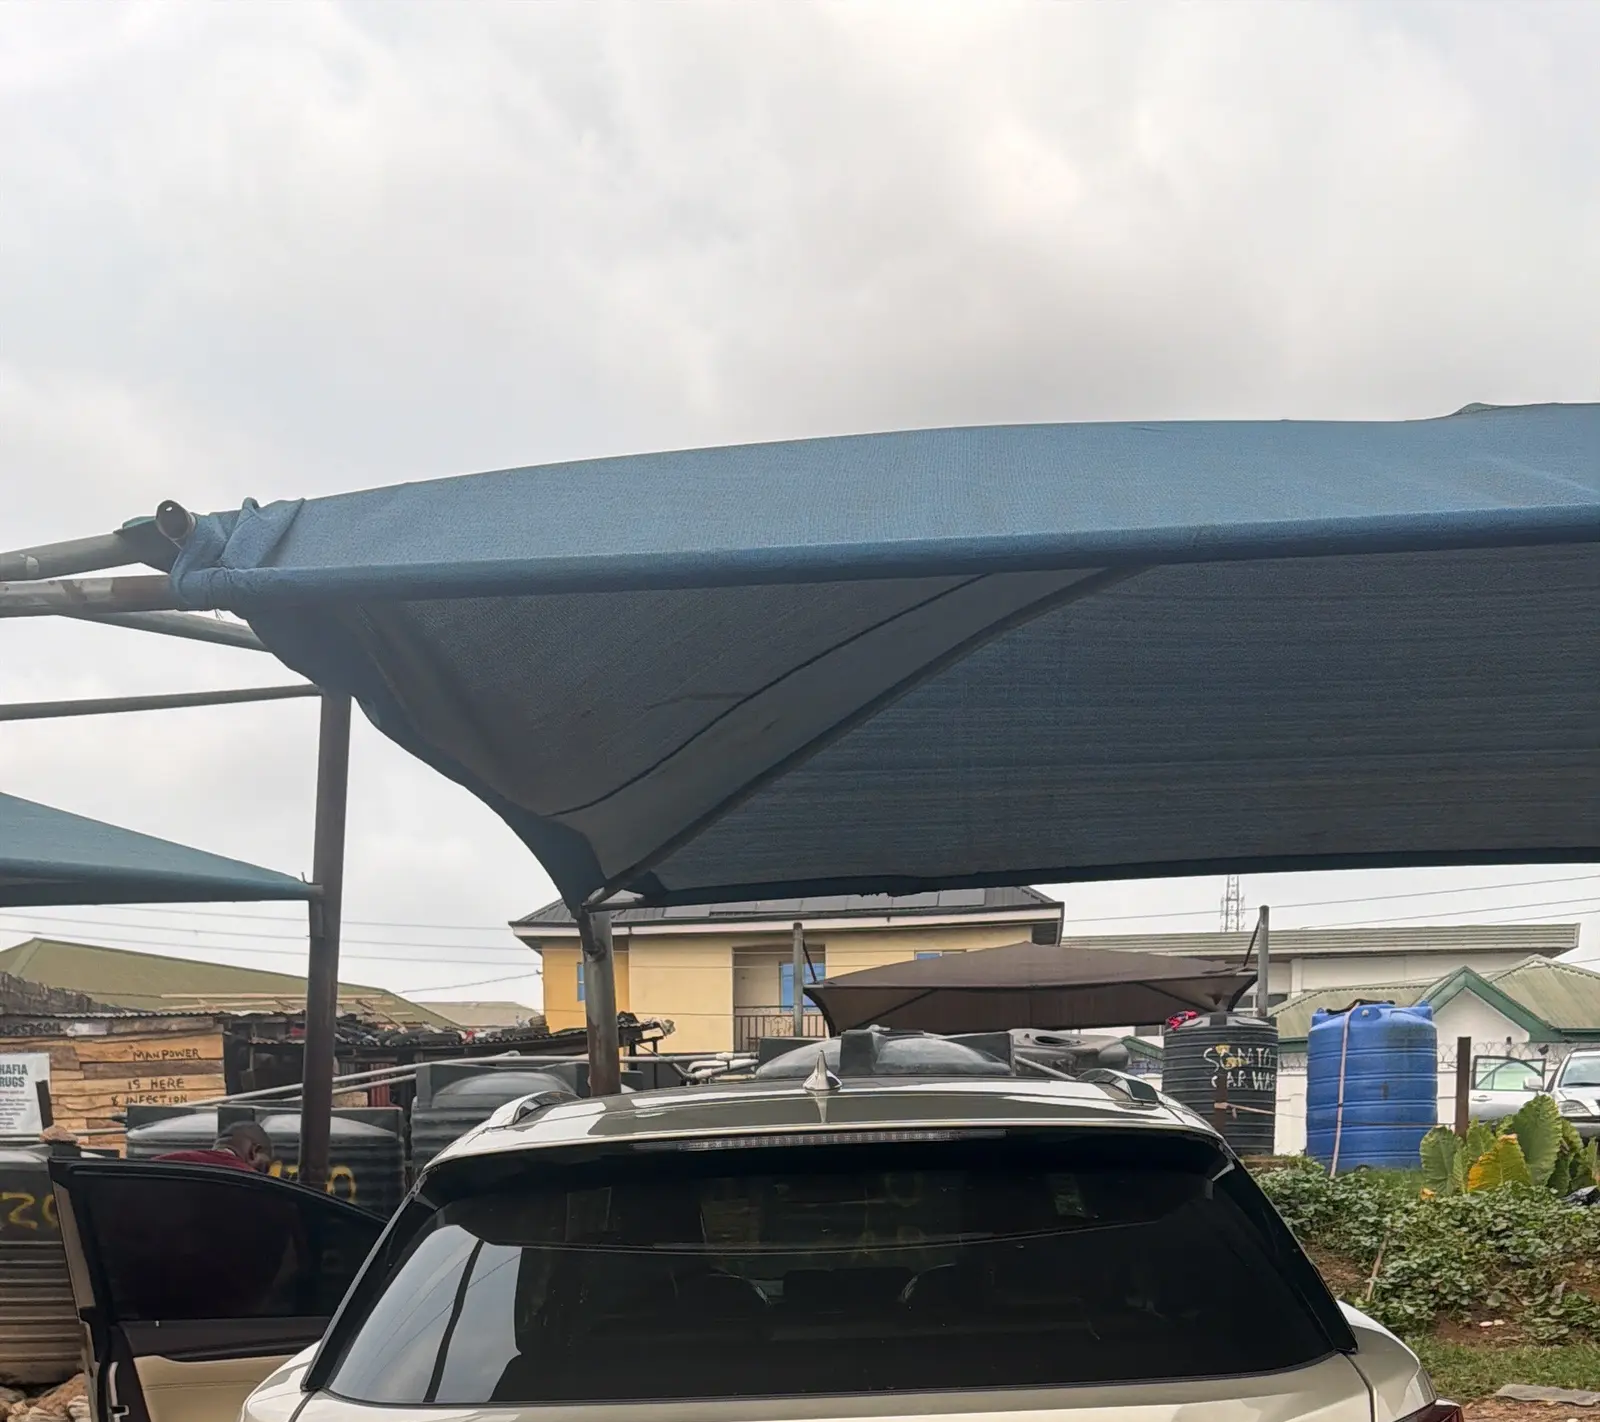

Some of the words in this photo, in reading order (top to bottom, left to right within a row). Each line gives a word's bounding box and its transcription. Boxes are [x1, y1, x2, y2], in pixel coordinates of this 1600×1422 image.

[133, 1048, 202, 1060] MANPOWER
[128, 1079, 140, 1090] IS
[150, 1078, 185, 1090] HERE
[126, 1095, 188, 1105] INFECTION
